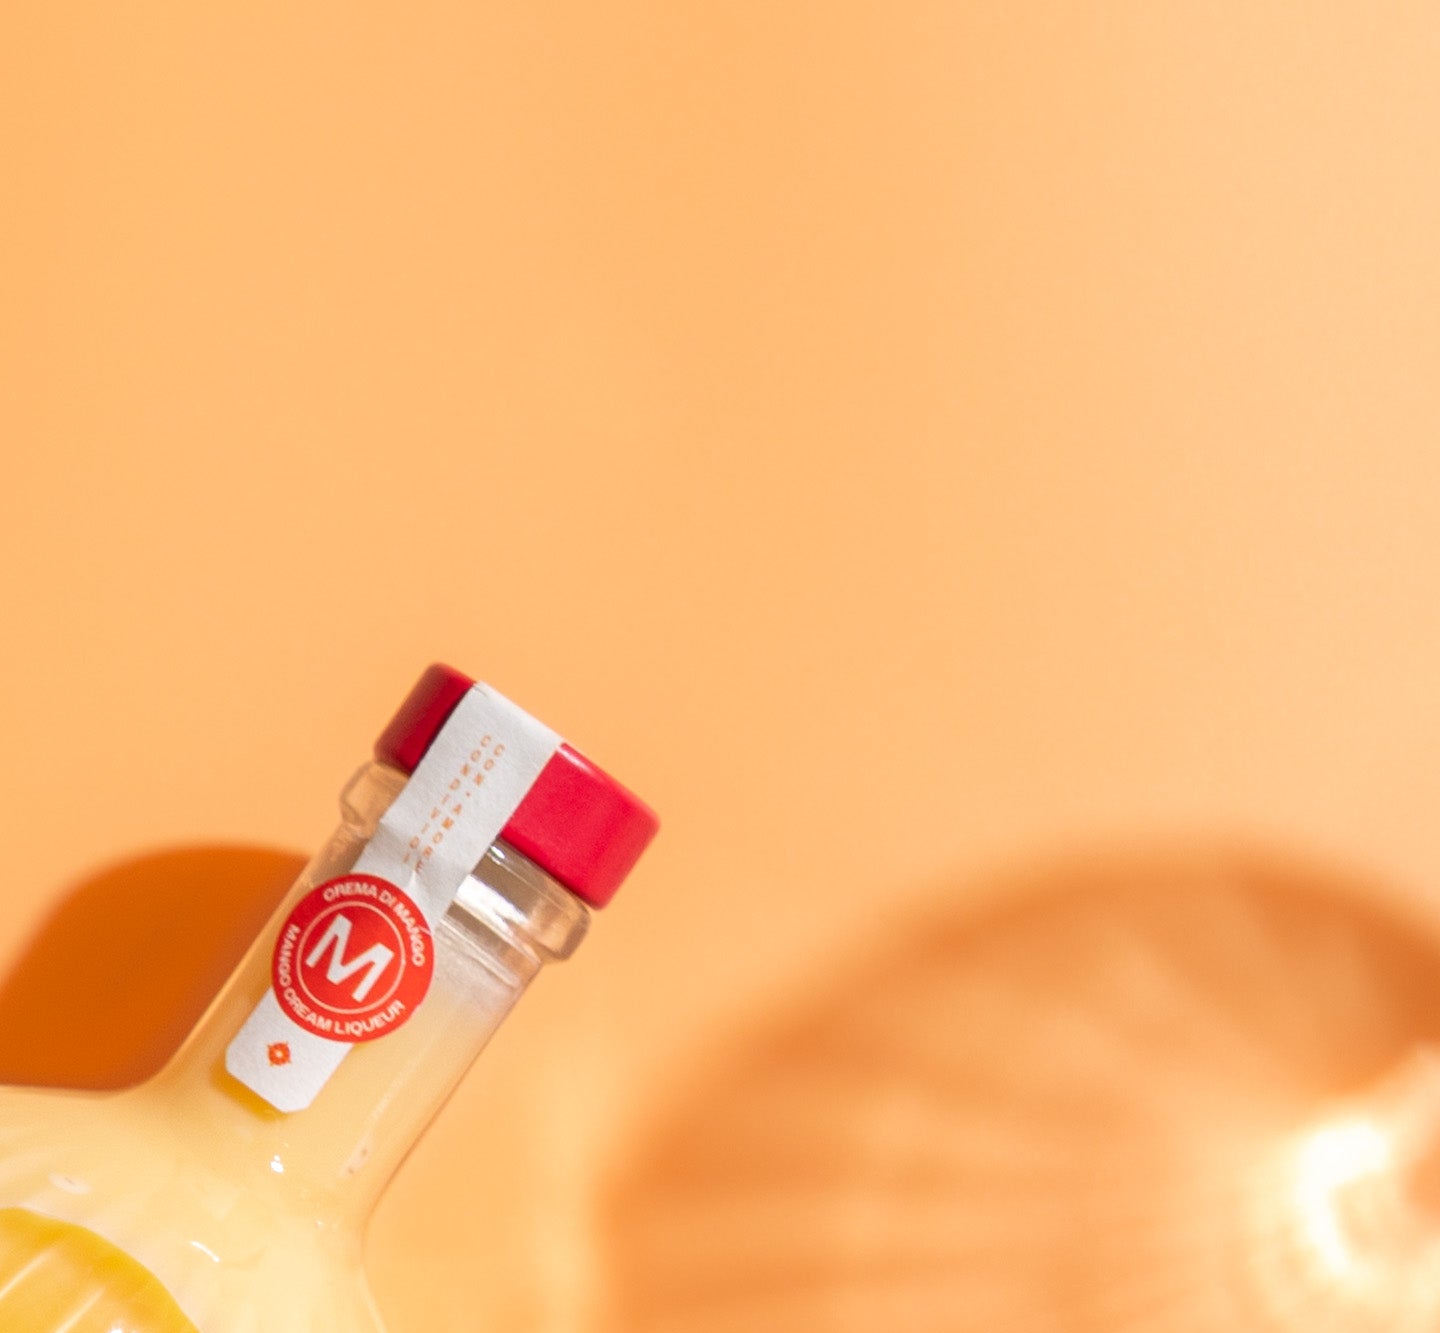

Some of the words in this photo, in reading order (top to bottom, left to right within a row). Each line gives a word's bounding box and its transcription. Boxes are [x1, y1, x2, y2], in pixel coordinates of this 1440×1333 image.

[279, 924, 300, 987] MANGO
[323, 882, 378, 901] CREMA
[379, 889, 396, 906] DI
[394, 903, 425, 967] MANGO
[305, 913, 394, 1003] M
[284, 988, 332, 1032] CREAM
[333, 1000, 405, 1037] LIQUEUR
